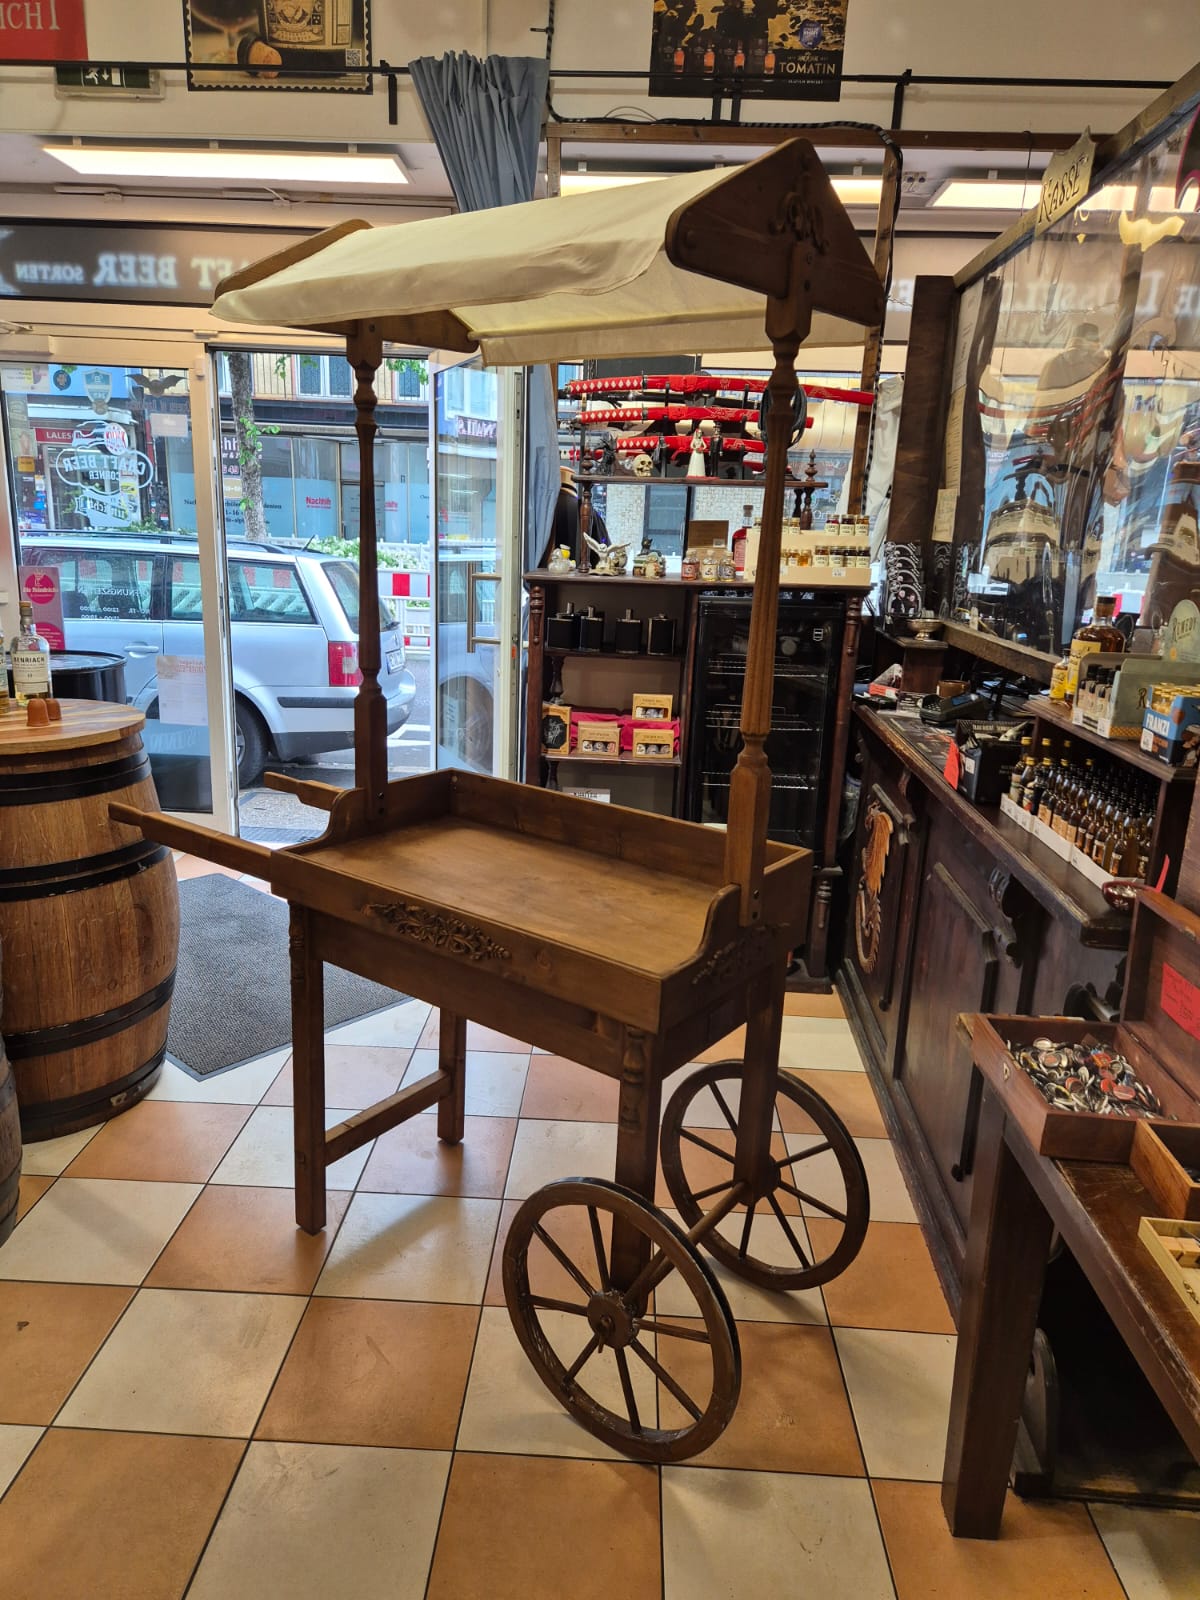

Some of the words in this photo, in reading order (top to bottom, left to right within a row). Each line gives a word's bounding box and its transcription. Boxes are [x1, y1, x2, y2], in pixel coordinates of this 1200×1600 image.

[779, 62, 836, 75] TOMATIN
[1038, 154, 1088, 224] KASSE
[1172, 615, 1198, 643] REMEDY
[13, 656, 46, 664] BENRIACH
[1146, 713, 1170, 737] FRANZI
